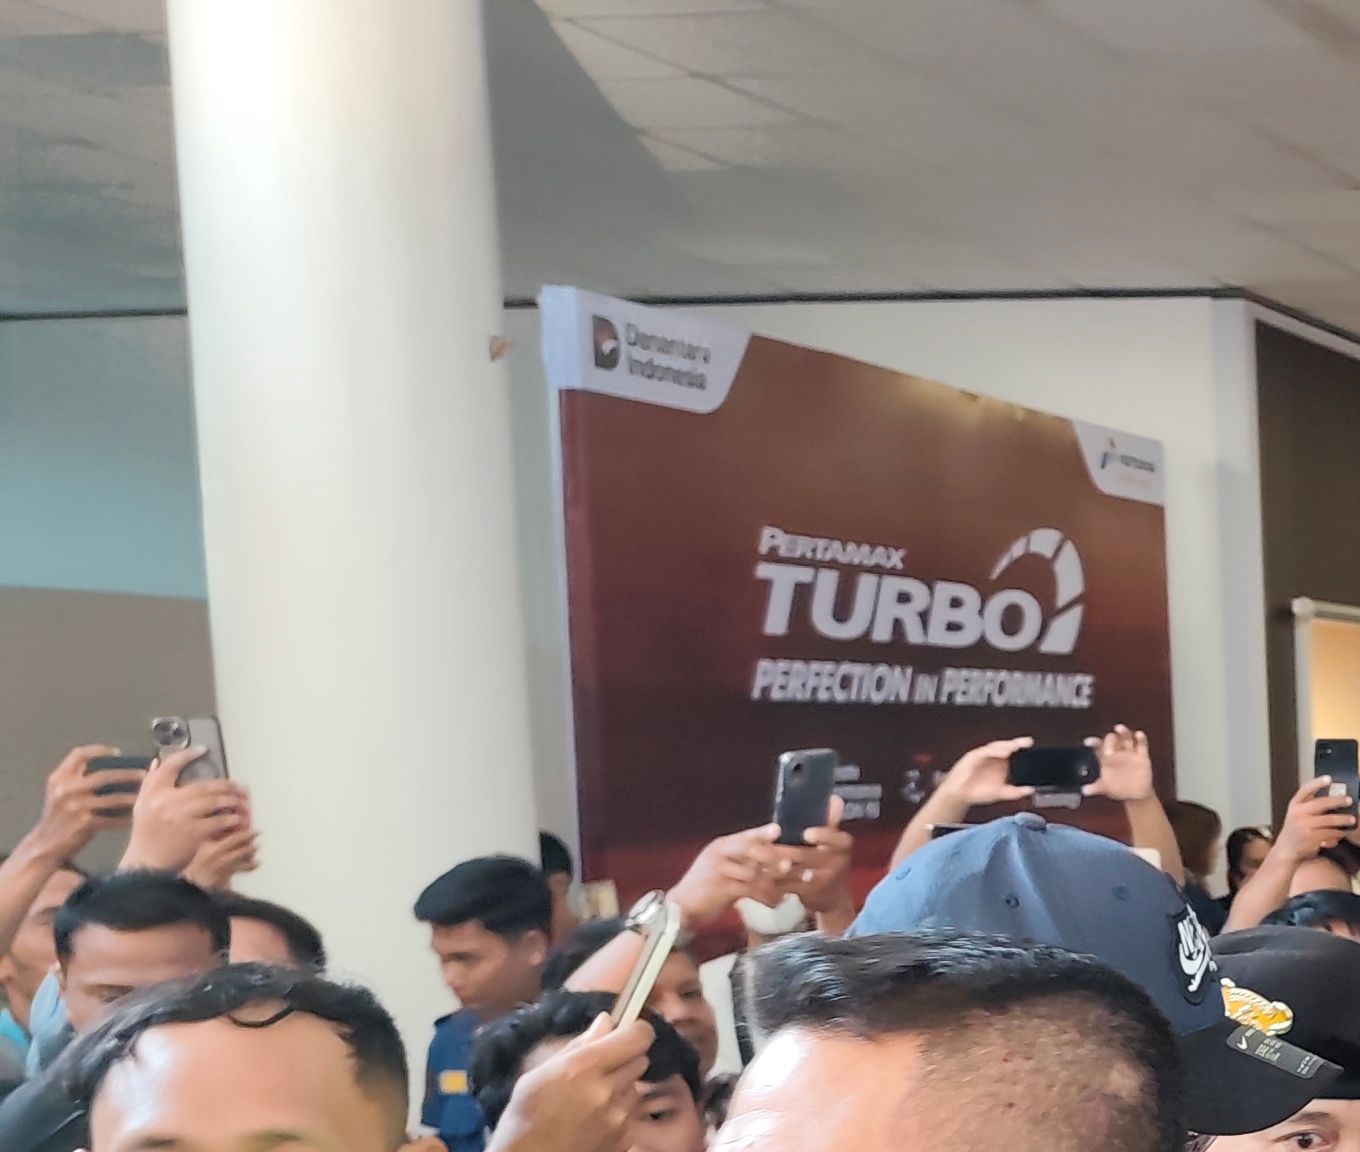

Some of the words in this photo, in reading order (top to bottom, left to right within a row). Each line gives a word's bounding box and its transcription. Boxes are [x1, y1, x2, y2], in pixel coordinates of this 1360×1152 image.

[758, 526, 906, 569] PERTAMAX
[755, 562, 1042, 651] TURBO
[752, 658, 912, 703] PERFECTION
[940, 666, 1094, 708] PERFORMANCE
